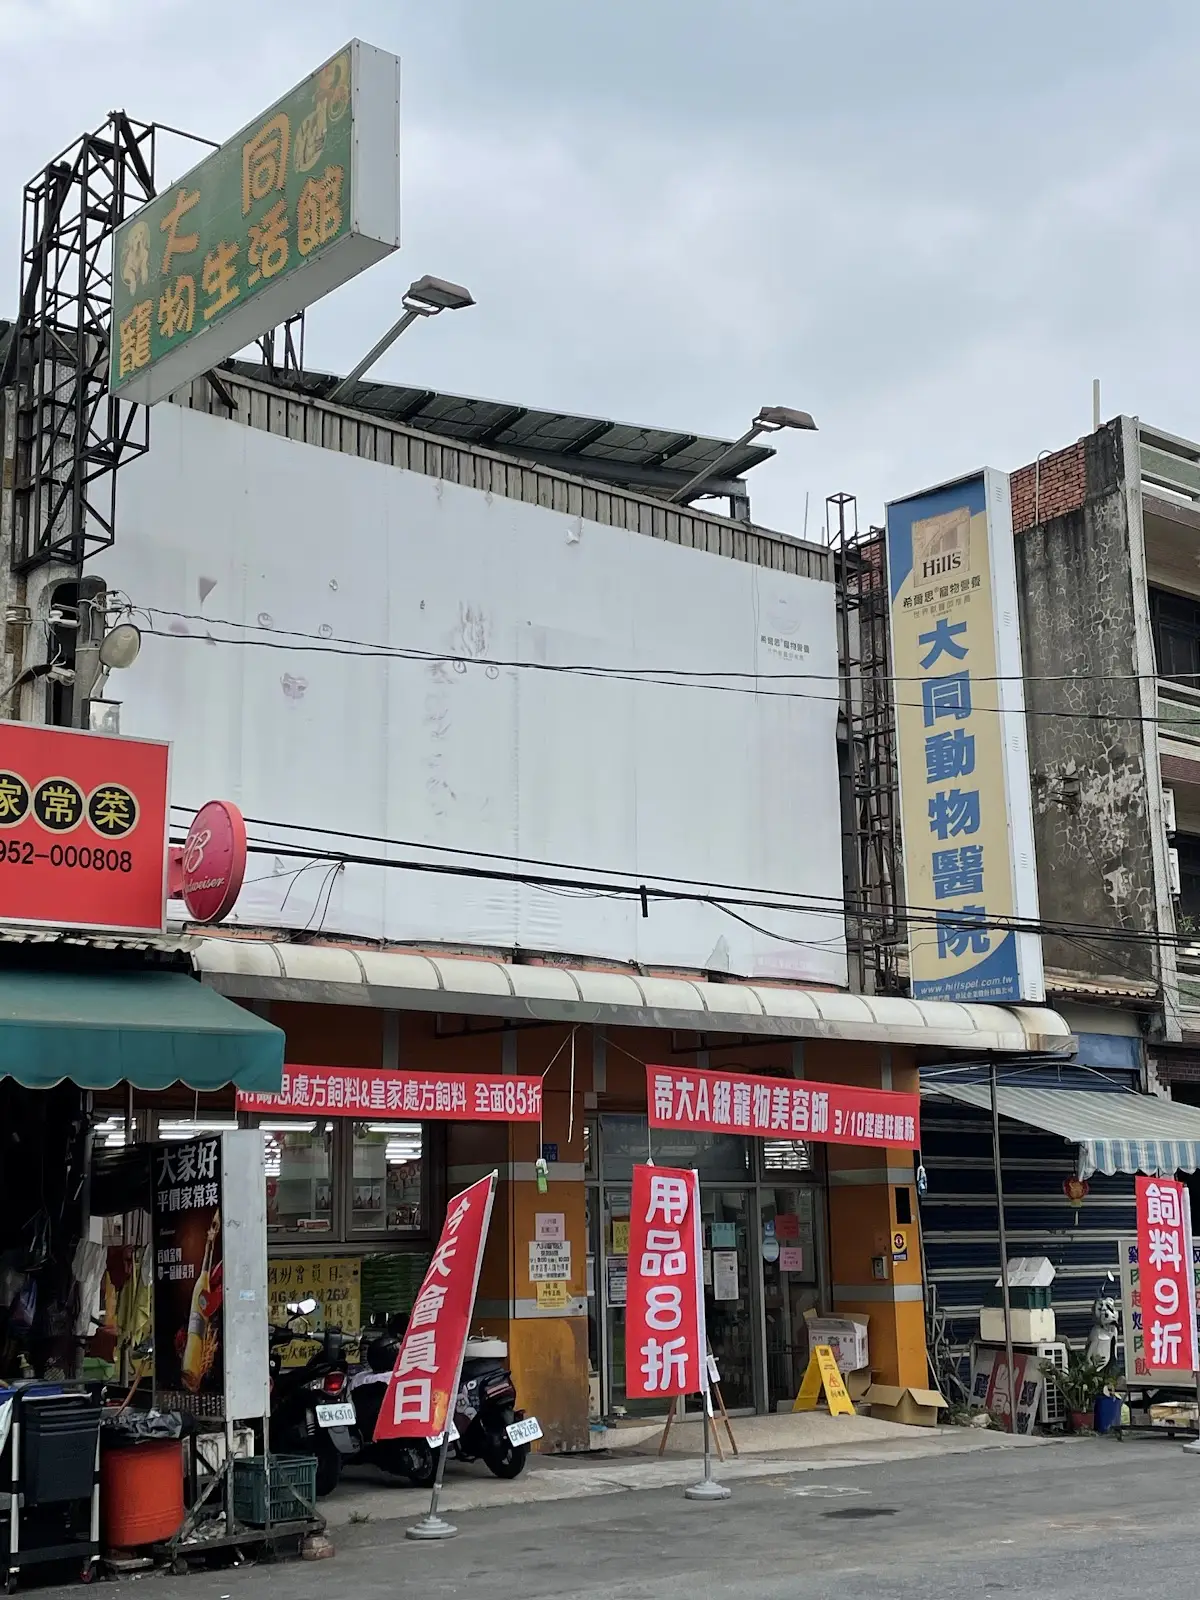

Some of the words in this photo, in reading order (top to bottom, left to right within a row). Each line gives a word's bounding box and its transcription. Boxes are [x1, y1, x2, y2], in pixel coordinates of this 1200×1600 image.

[119, 164, 344, 378] 寵物生活館
[922, 551, 961, 578] Hill's
[918, 618, 991, 959] 大同動物醫院
[475, 1081, 541, 1115] 全面85折
[654, 1074, 829, 1135] 帝大A級寵物美容師
[156, 1139, 218, 1187] 大家好
[157, 1182, 219, 1213] 平價家常菜
[393, 1196, 470, 1425] 今天會員日
[639, 1175, 689, 1391] 用品8折
[1146, 1183, 1182, 1365] 飼料9折
